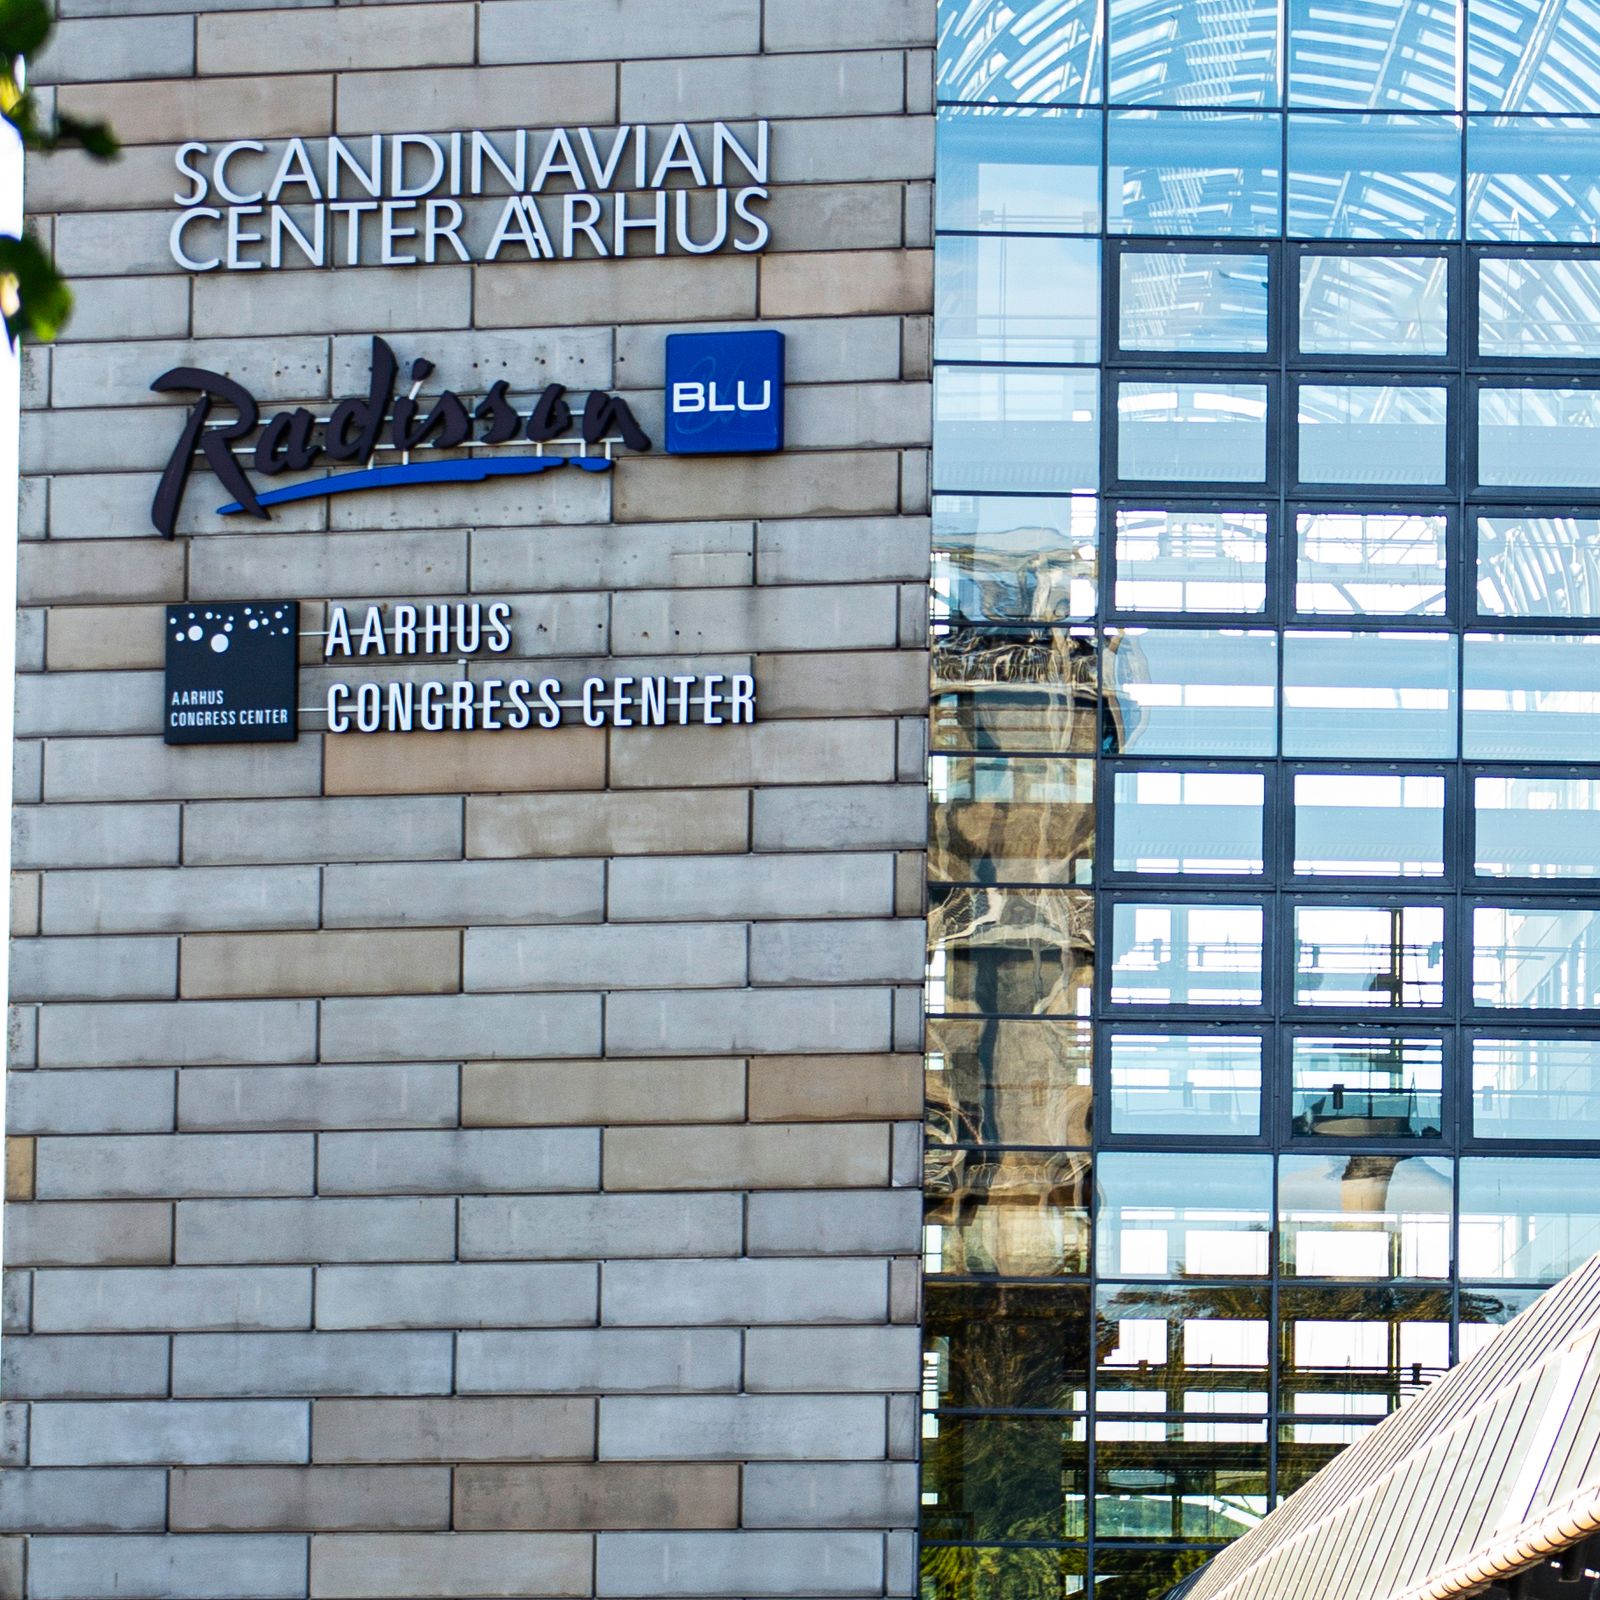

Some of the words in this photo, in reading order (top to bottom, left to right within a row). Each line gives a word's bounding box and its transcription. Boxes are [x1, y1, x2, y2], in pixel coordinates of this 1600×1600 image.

[173, 120, 769, 207] SCANDINAVIAN
[169, 198, 471, 271] CENTER
[149, 335, 652, 541] Radisson
[672, 379, 772, 414] BLU
[325, 602, 512, 657] AARHUS
[170, 710, 237, 727] CONGRESS
[239, 709, 289, 725] CENTER
[171, 690, 224, 706] AARHUS
[327, 678, 562, 734] CONGRESS
[582, 674, 757, 728] CENTER
